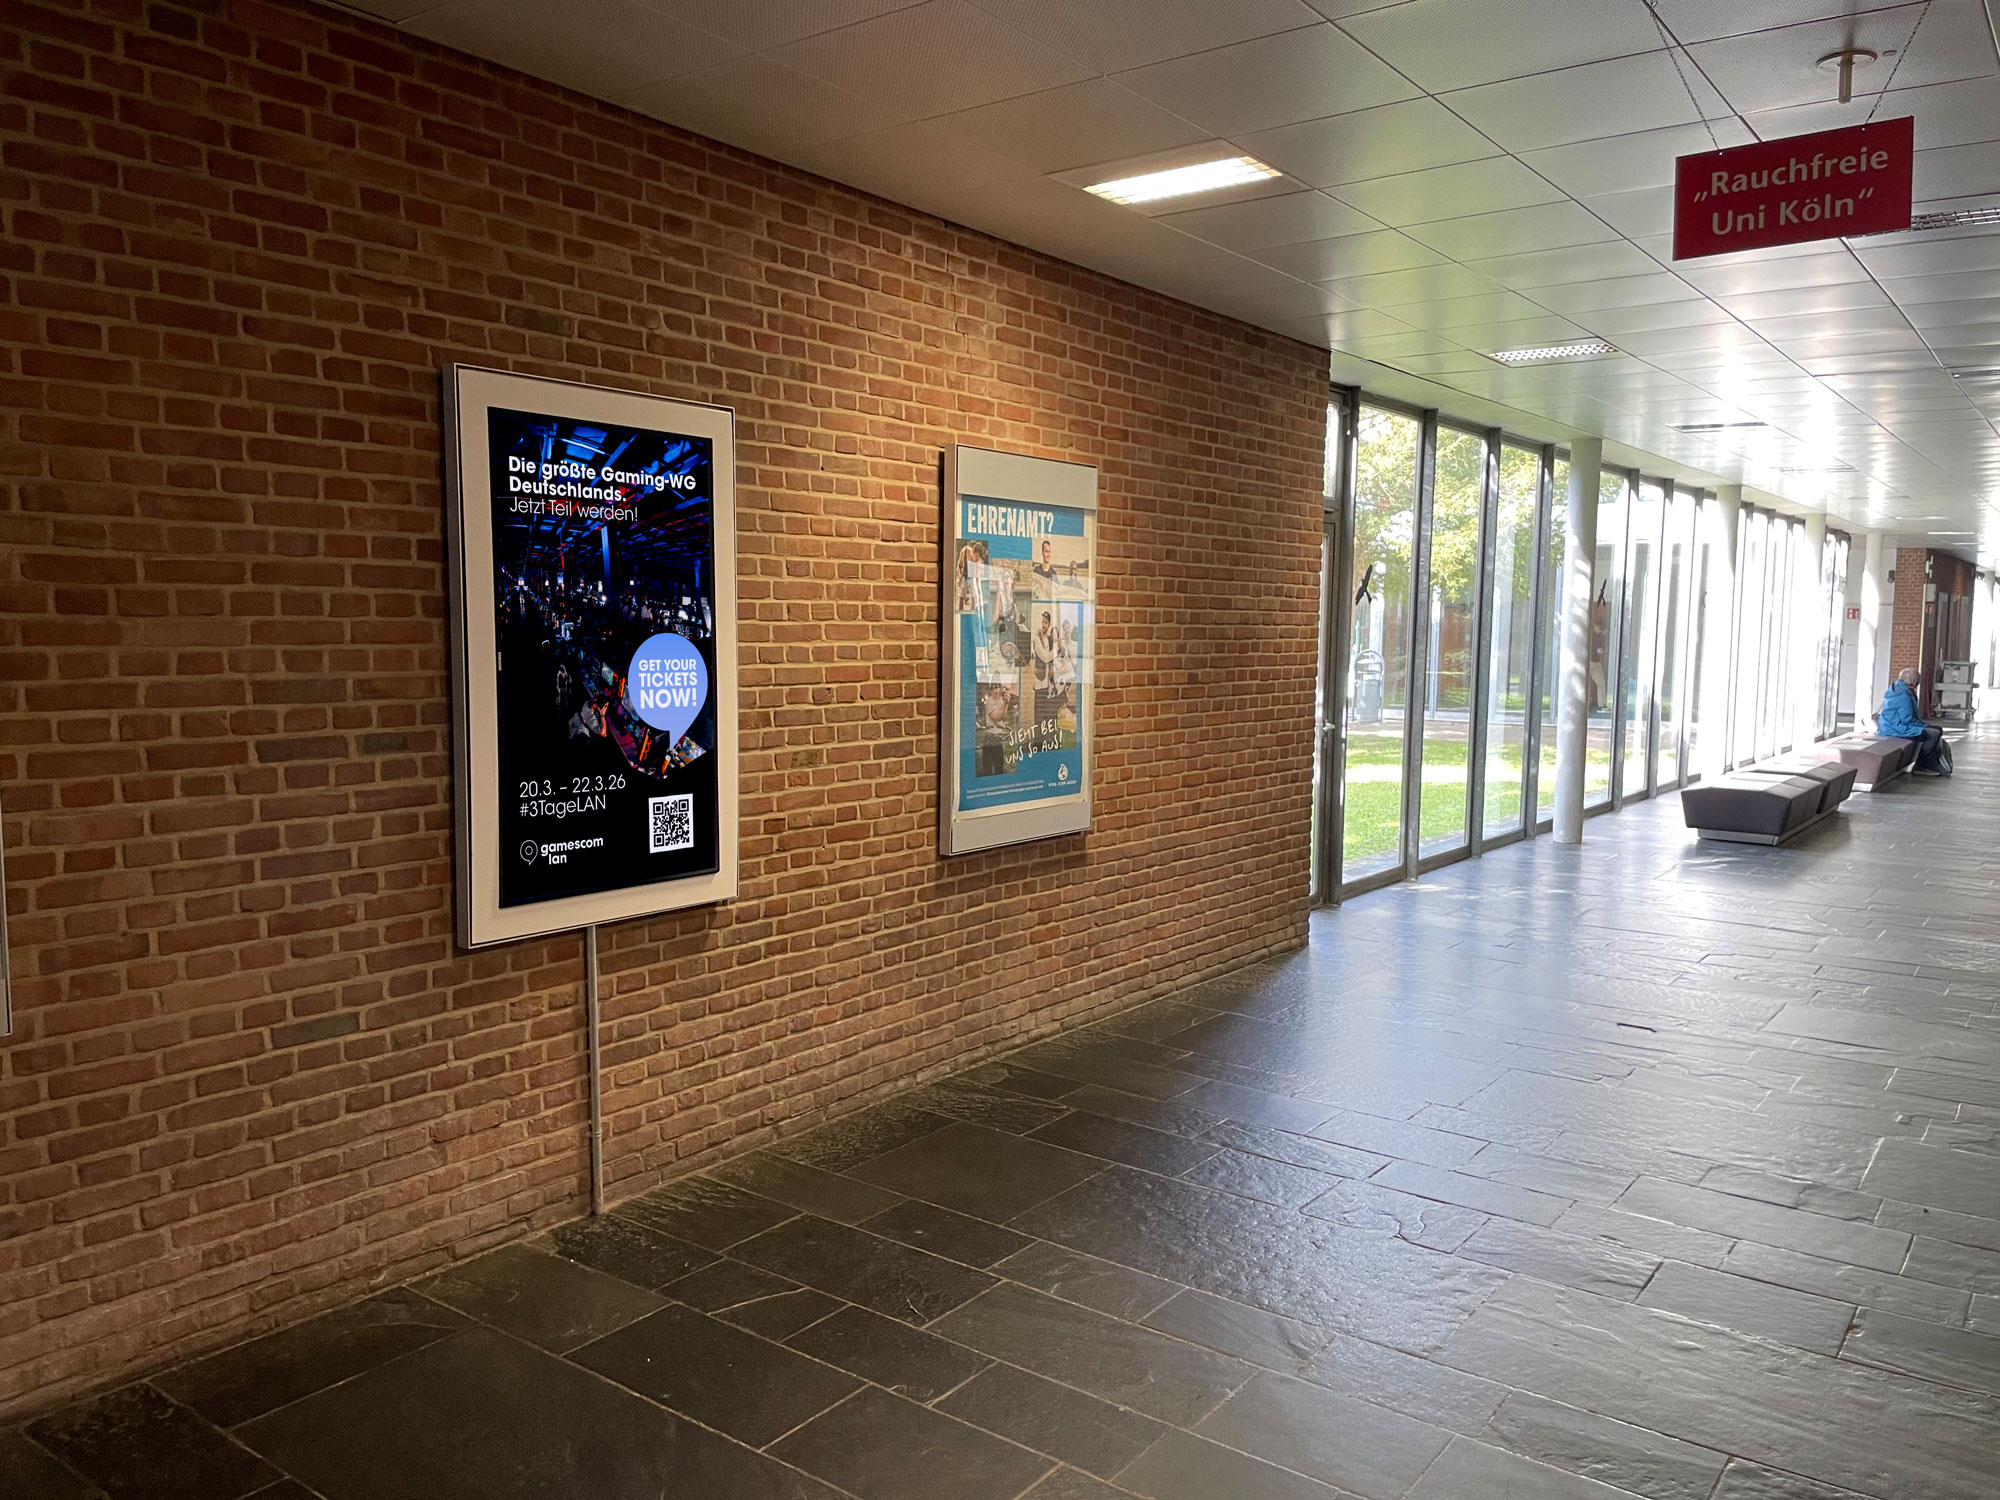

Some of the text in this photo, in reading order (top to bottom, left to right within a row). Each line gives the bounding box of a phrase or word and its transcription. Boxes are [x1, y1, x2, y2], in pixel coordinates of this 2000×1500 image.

[1693, 146, 1889, 203] „Rauchfreie
[1712, 187, 1874, 236] Uni Köln“
[508, 456, 697, 492] Die größte Gaming-WG
[509, 476, 627, 502] Deutschlands.
[510, 497, 638, 522] Jetzt Teil werden!
[967, 503, 1054, 539] EHRENAMT?
[639, 658, 697, 671] GET YOUR
[639, 672, 698, 688] TICKETS
[640, 688, 697, 709] NOW!
[1009, 719, 1057, 746] SIEHT BEI
[1005, 746, 1024, 764] UNS
[1041, 729, 1063, 753] AUS!
[519, 780, 556, 798] 20.3.
[572, 774, 626, 794] 22.3.26
[519, 795, 606, 819] #3TageLAN
[540, 837, 604, 857] gamescom
[548, 853, 567, 865] lan
